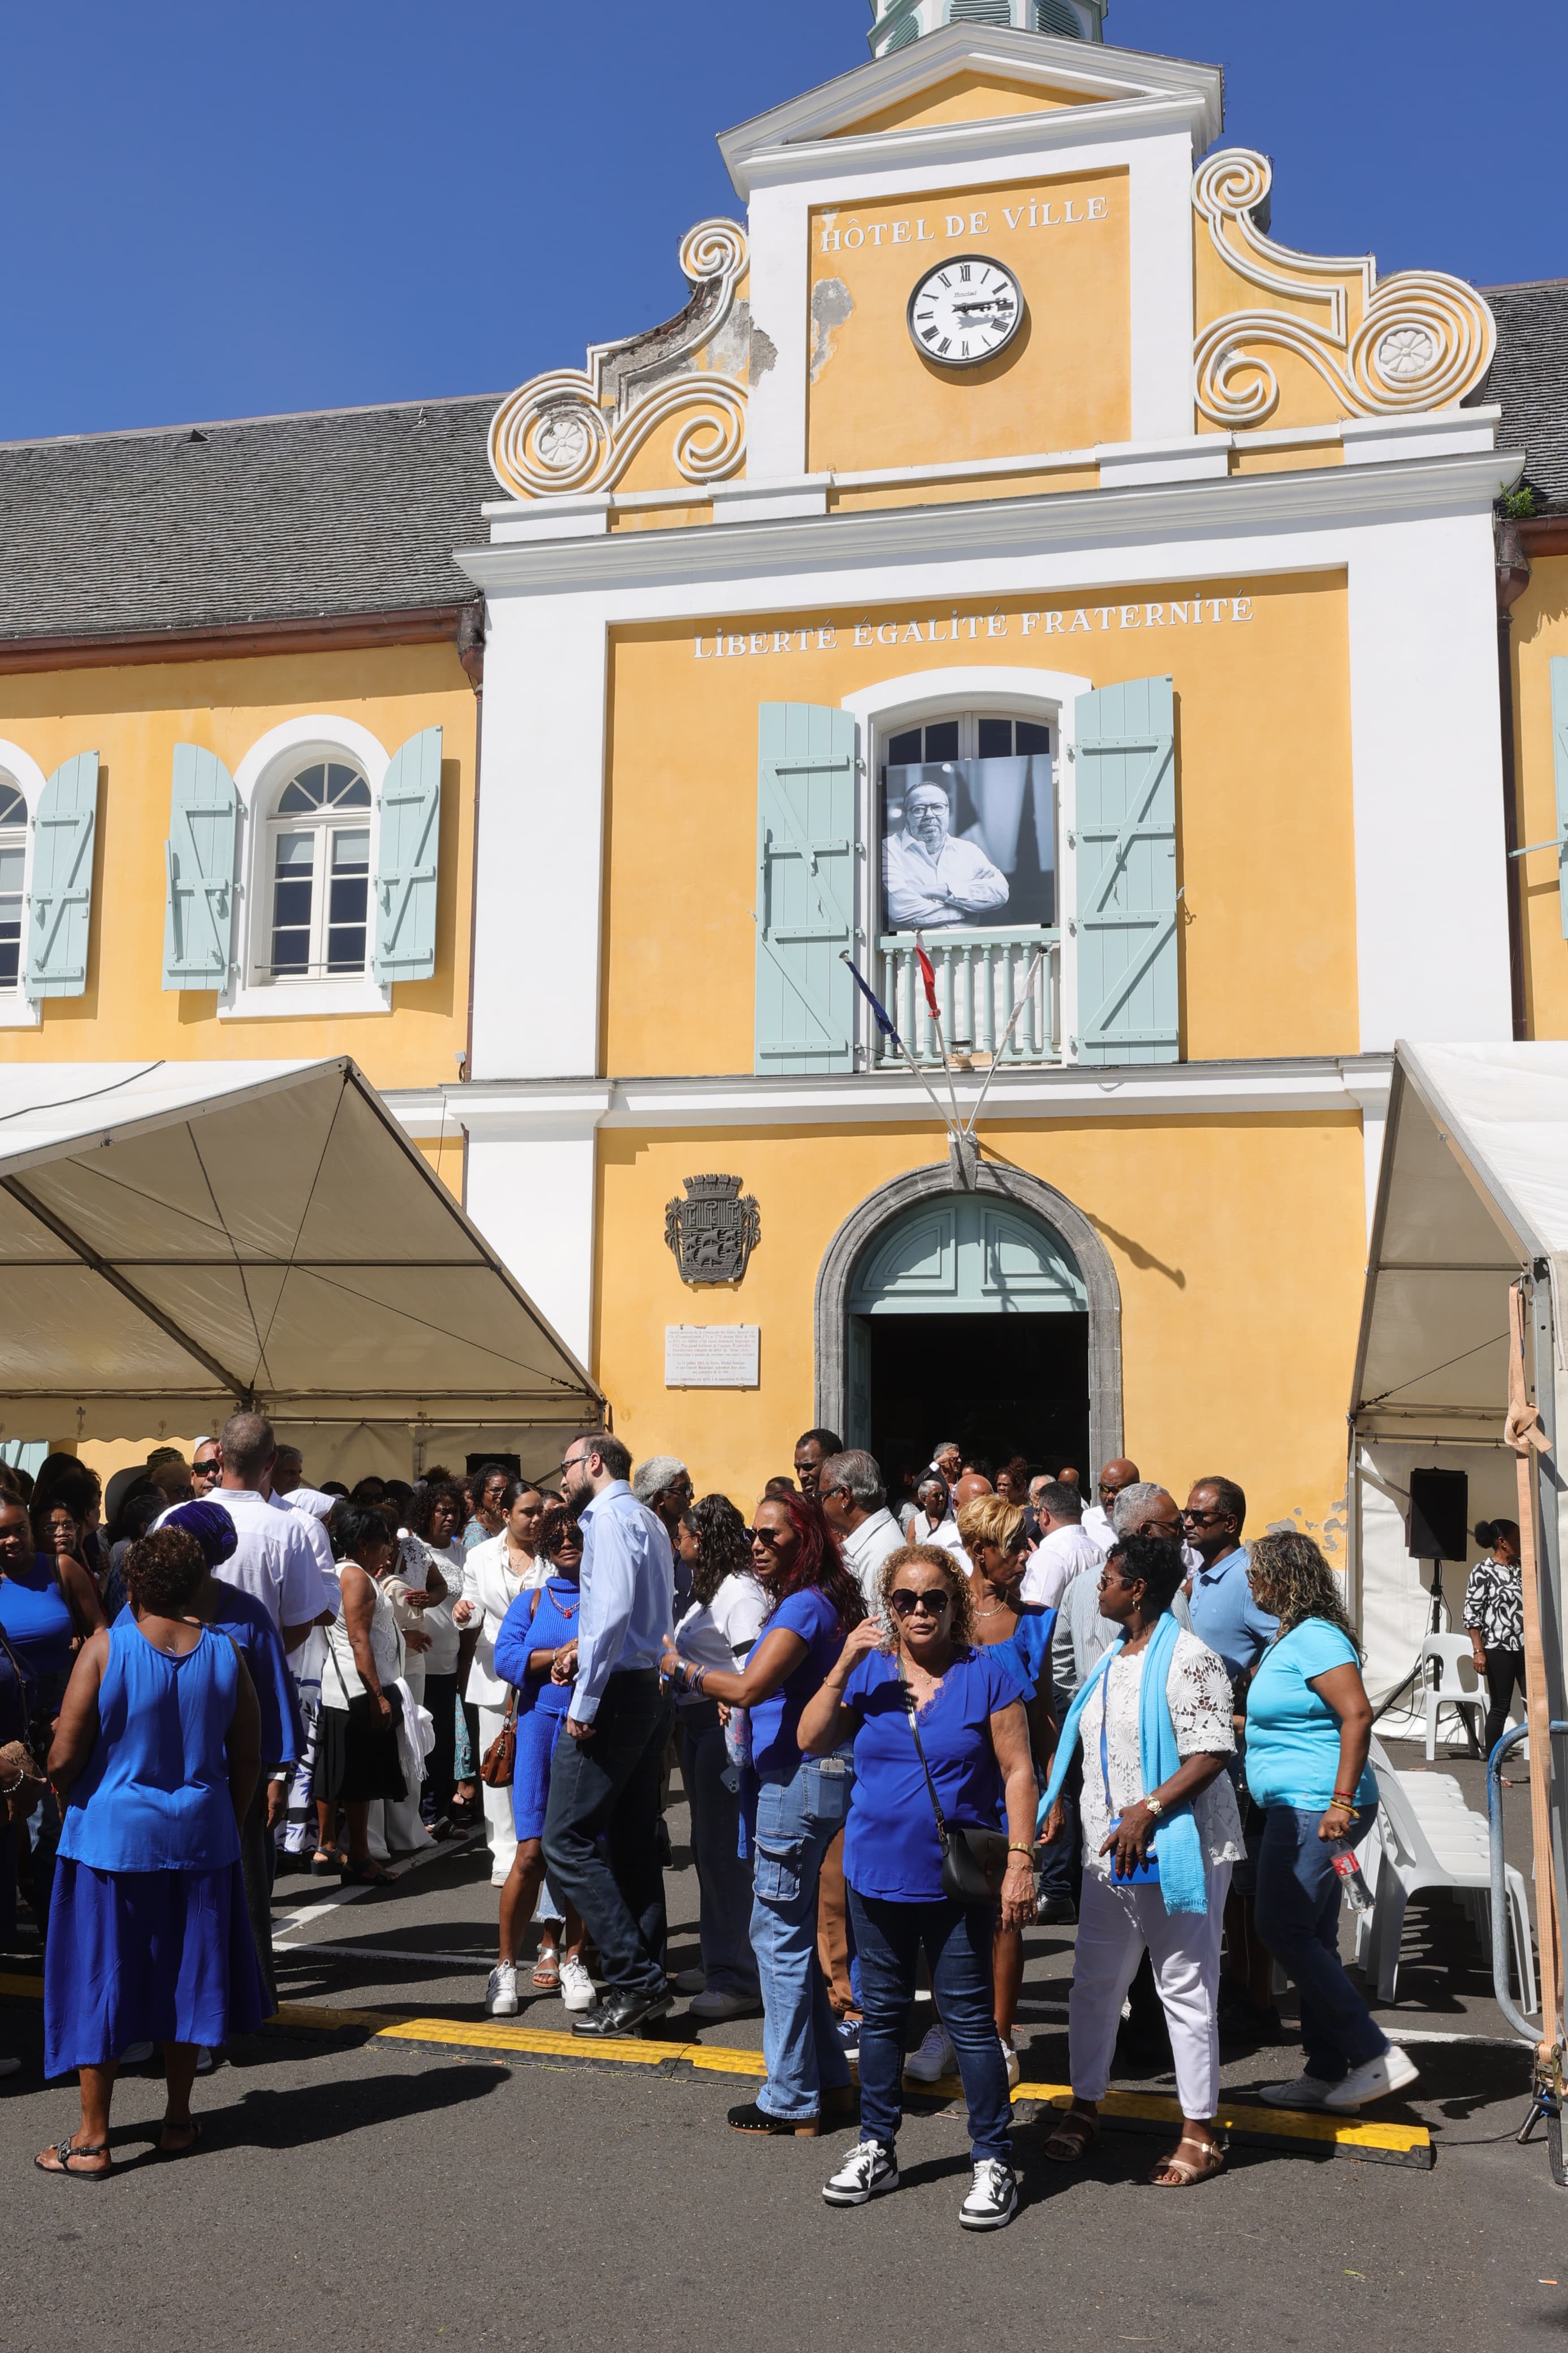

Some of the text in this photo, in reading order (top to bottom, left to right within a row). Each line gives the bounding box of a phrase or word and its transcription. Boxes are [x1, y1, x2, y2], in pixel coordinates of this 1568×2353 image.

[821, 218, 935, 252] HÔTEL
[945, 211, 990, 238] DE
[959, 265, 971, 283] XII
